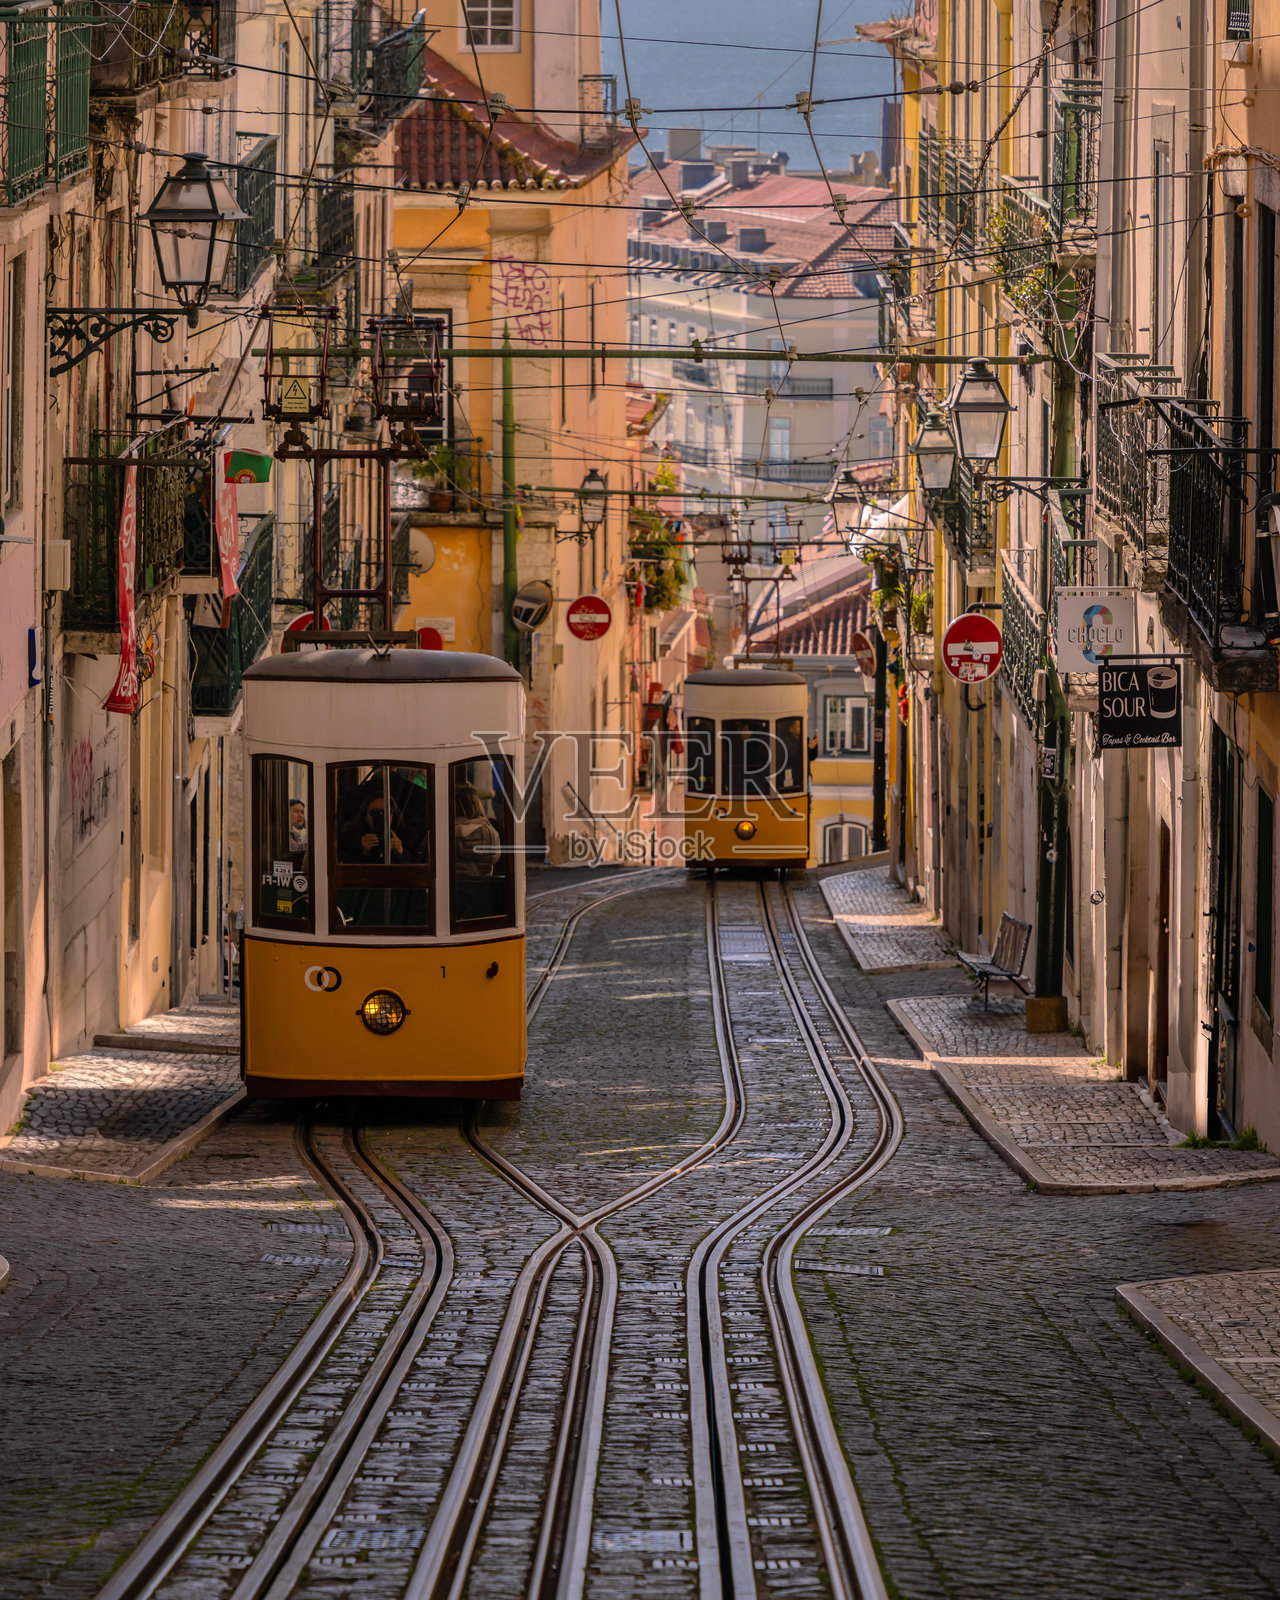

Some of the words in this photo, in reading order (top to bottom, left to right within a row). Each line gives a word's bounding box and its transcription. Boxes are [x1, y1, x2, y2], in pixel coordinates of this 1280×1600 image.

[1068, 626, 1124, 643] CHOCLO
[1102, 671, 1140, 692] BICA
[1102, 697, 1147, 718] SOUR
[1102, 733, 1124, 746] Tapas
[1132, 733, 1161, 745] Cocktail
[1161, 732, 1177, 744] Bar
[440, 965, 446, 979] 1
